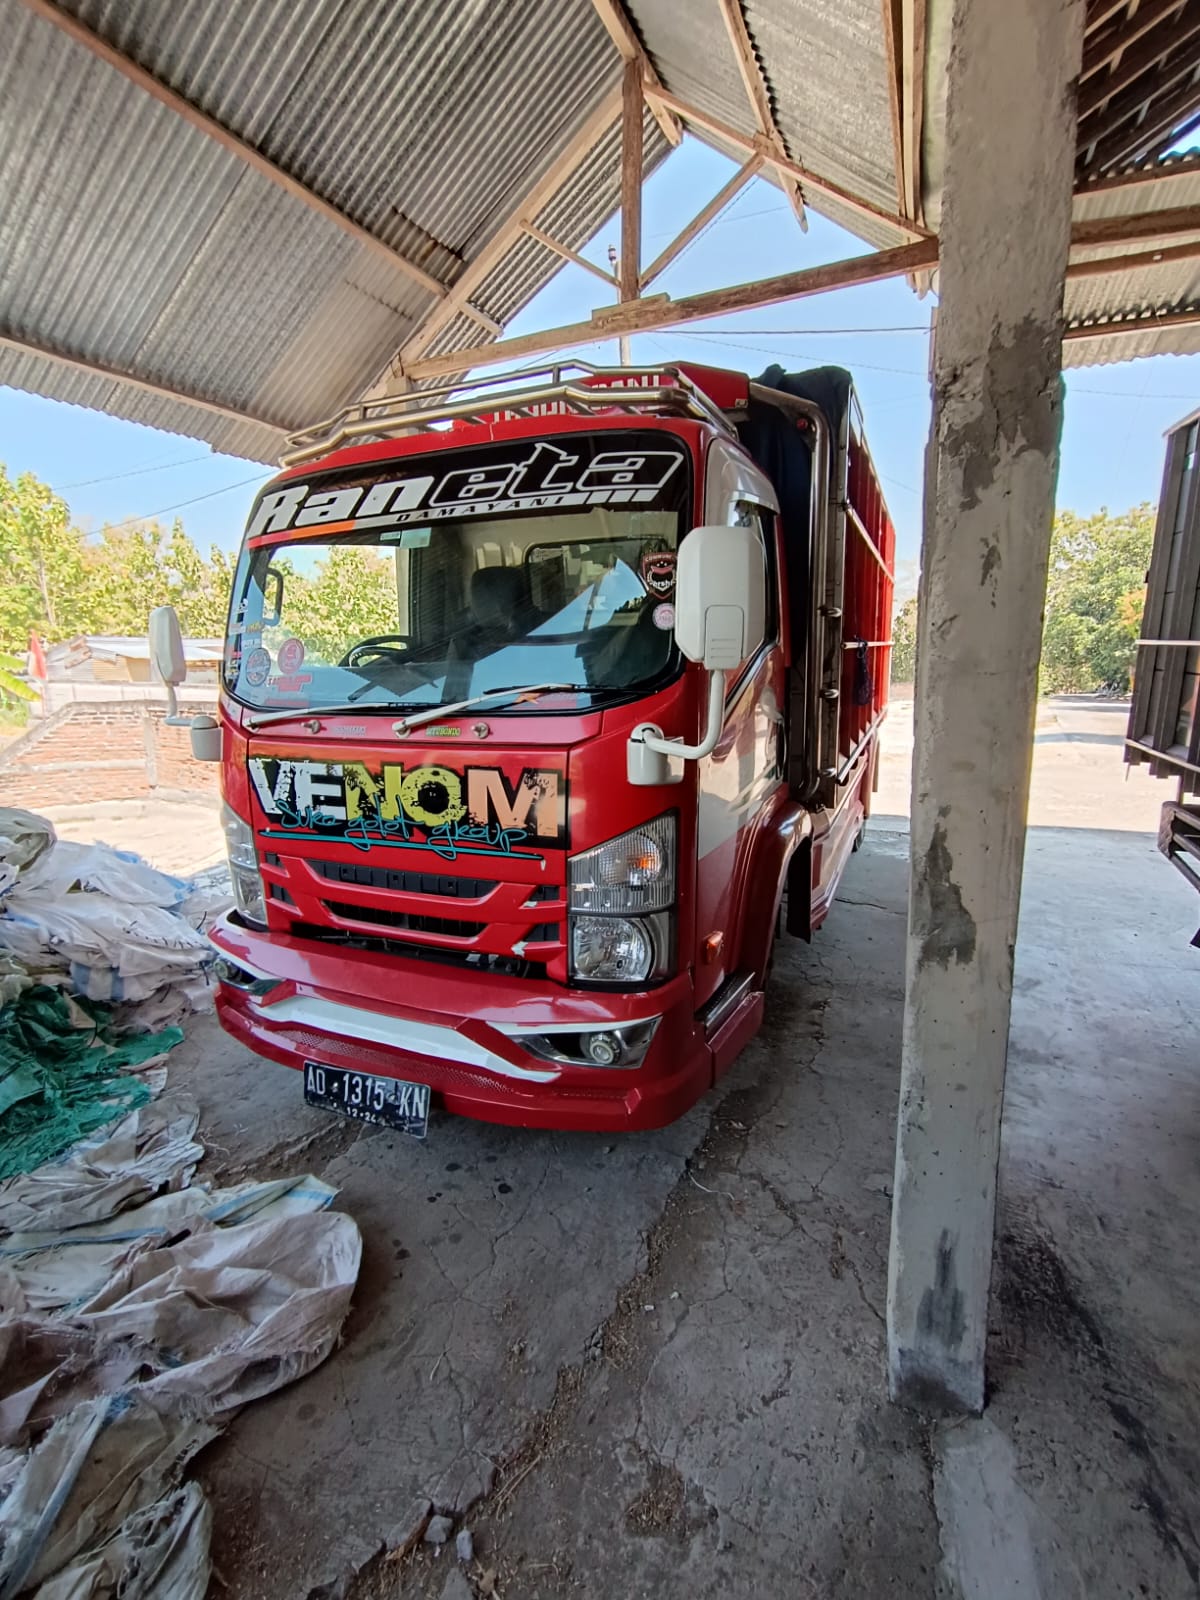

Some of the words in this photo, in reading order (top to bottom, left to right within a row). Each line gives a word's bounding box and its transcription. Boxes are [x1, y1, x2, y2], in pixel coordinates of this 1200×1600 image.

[396, 496, 565, 522] DAMAYANI
[248, 758, 559, 838] VENOM
[306, 1065, 327, 1096] AD
[342, 1072, 387, 1111] 1315
[399, 1086, 426, 1119] KN
